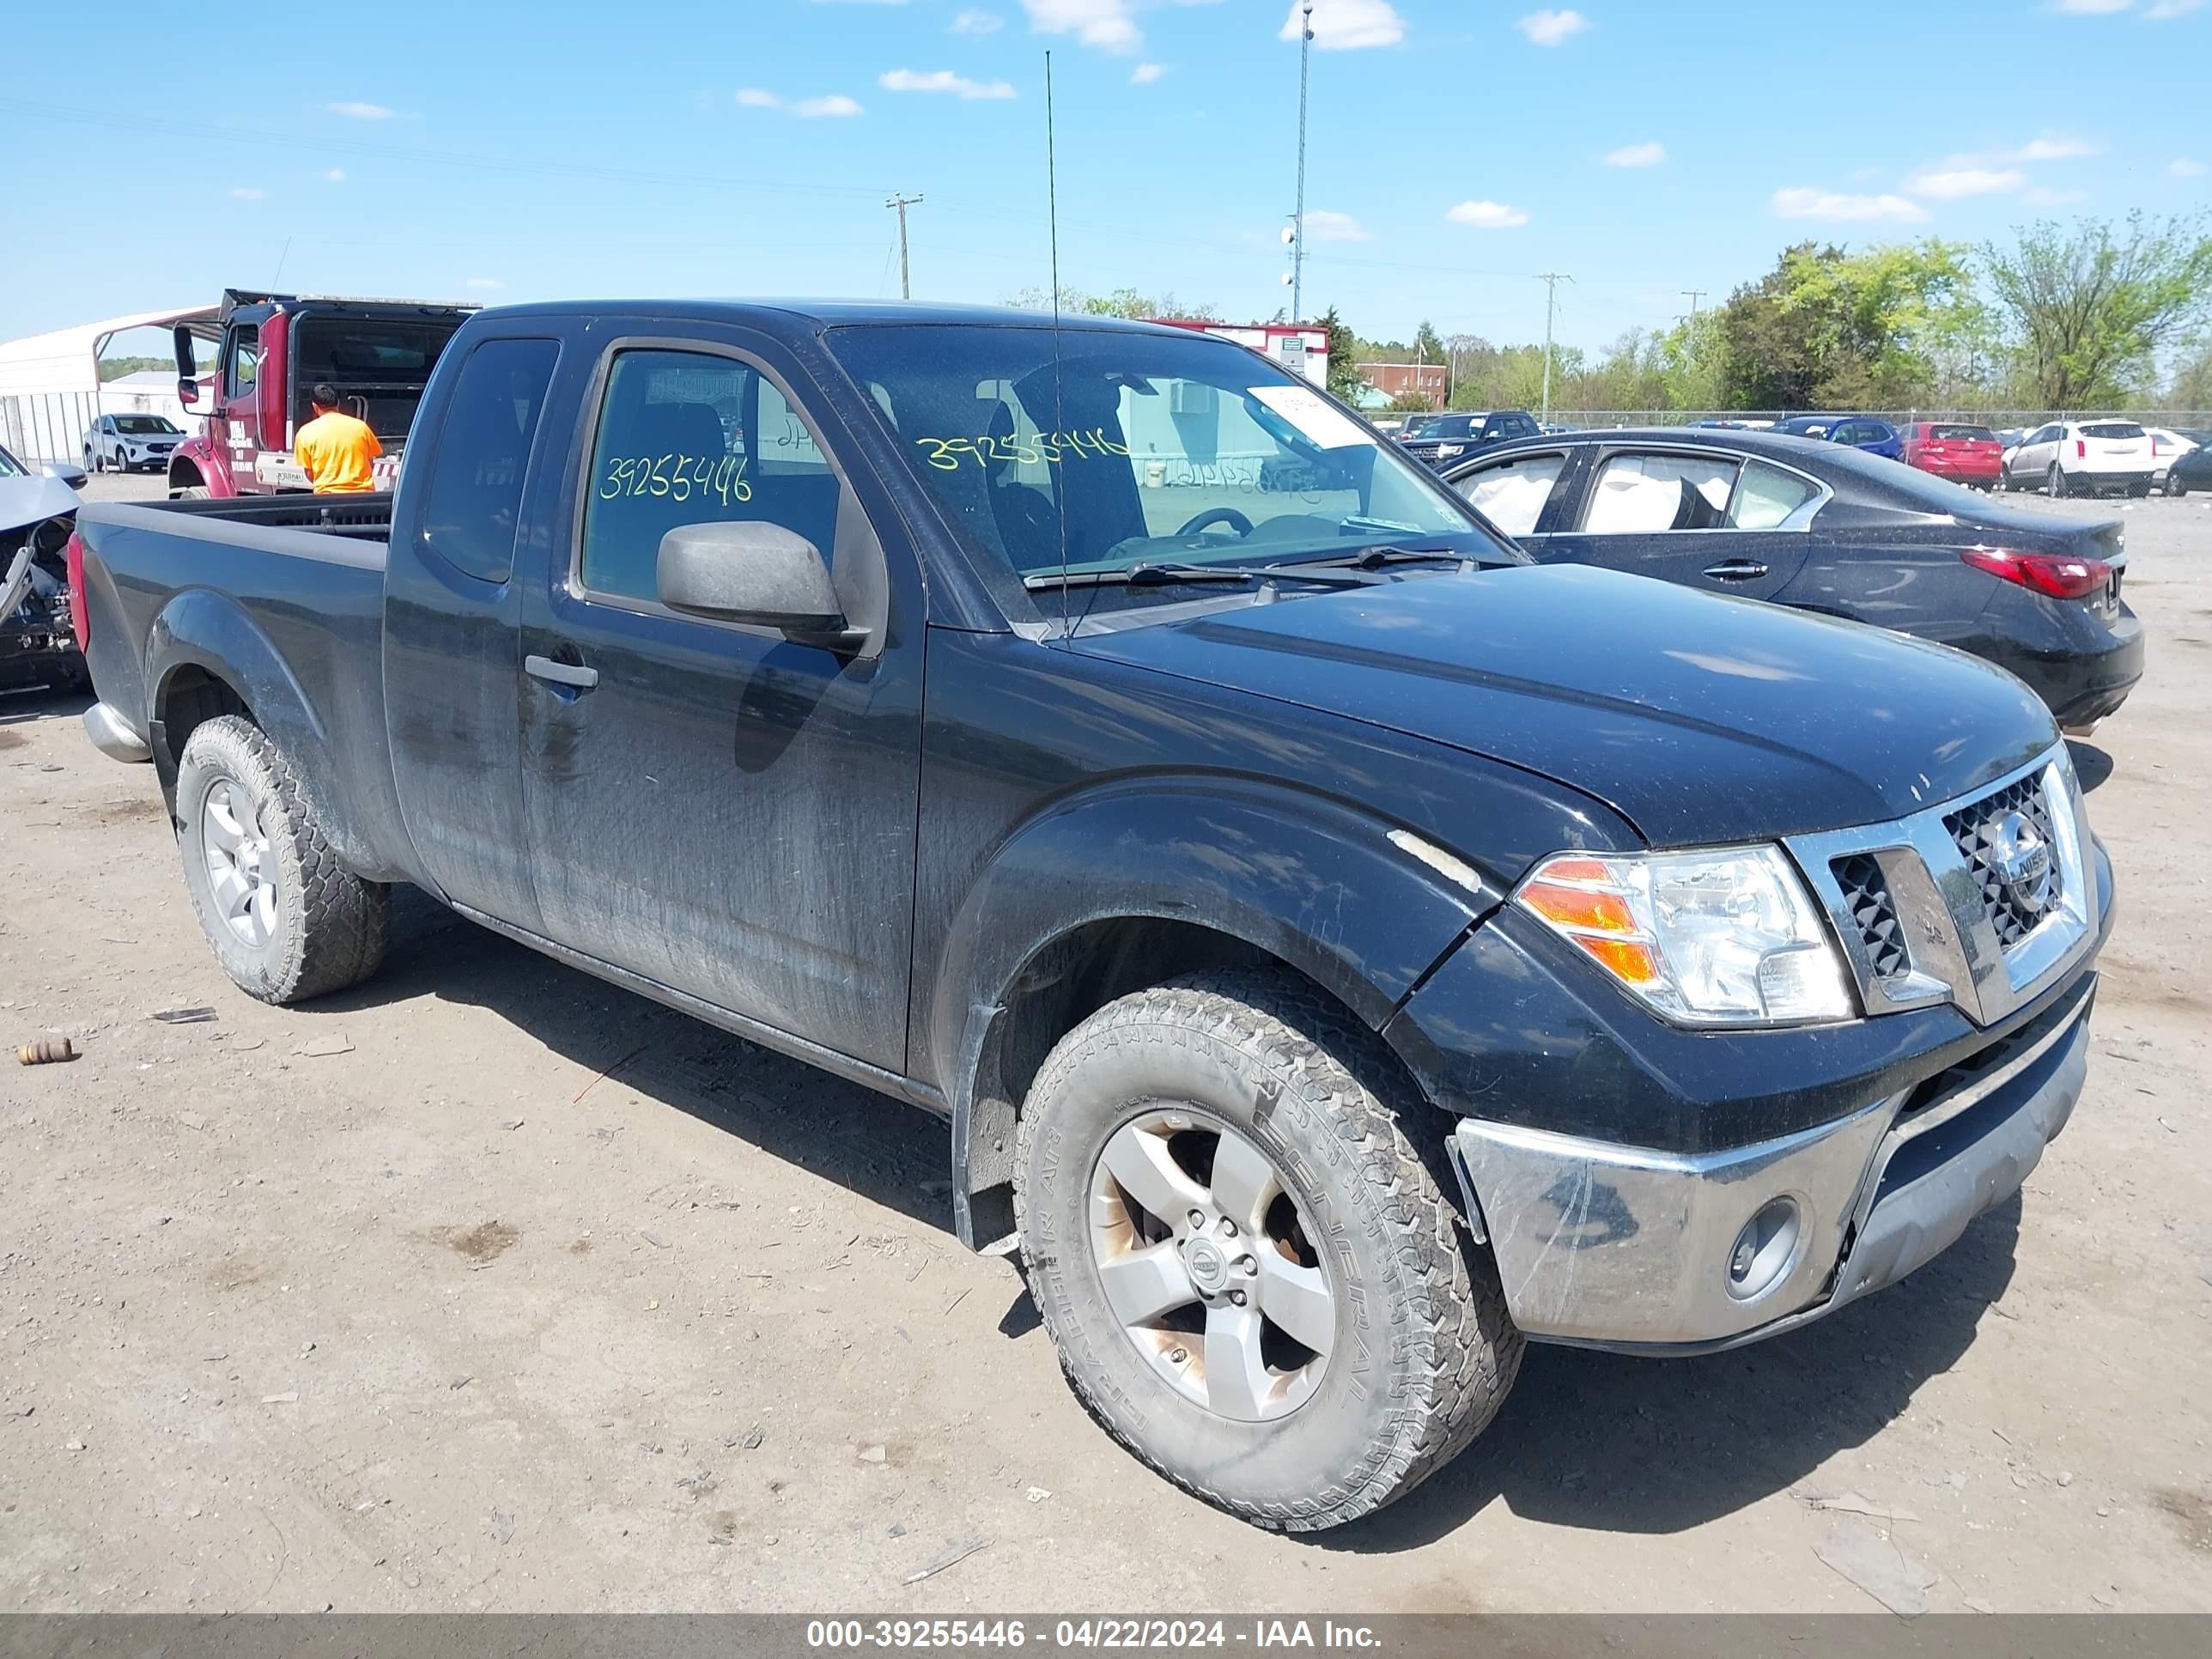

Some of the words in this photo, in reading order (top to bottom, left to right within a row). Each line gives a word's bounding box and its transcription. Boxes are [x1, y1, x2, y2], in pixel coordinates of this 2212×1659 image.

[915, 426, 1131, 471] 39255446
[599, 453, 752, 507] 39255446
[1250, 1109, 1370, 1409] GENERAL
